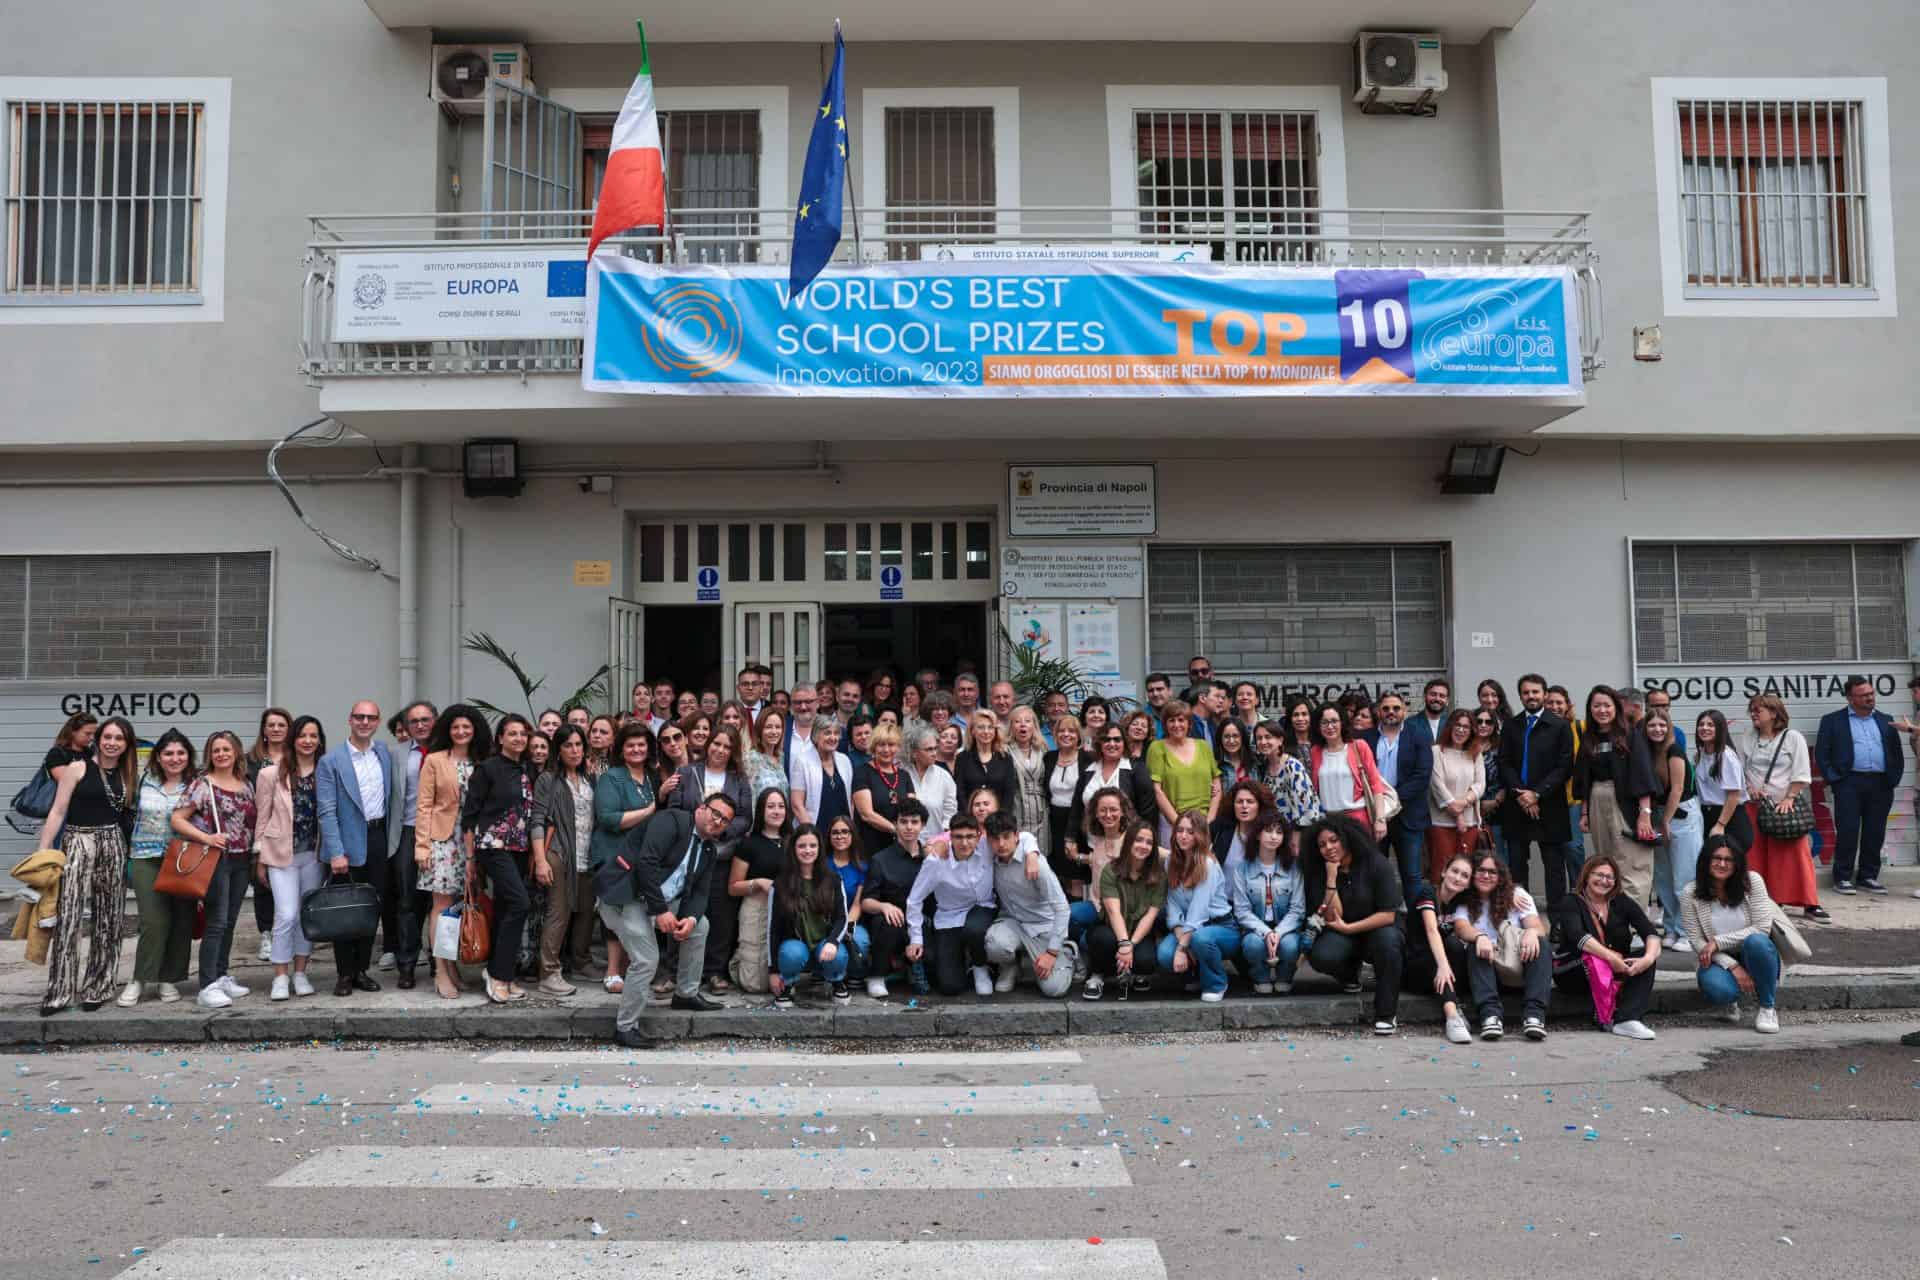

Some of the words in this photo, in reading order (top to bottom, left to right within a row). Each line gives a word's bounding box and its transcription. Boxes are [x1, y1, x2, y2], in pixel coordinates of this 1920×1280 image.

[523, 261, 545, 269] STATO
[972, 251, 1012, 259] ISTITUTO
[1015, 251, 1054, 259] STATALE
[1057, 251, 1109, 259] ISTRUZIONE
[1112, 251, 1160, 259] SUPERIORE
[447, 279, 520, 296] EUROPA
[774, 278, 953, 311] WORLD'S
[970, 278, 1069, 308] BEST
[776, 322, 955, 355] SCHOOL
[970, 321, 1105, 352] PRIZES
[1162, 309, 1307, 356] TOP
[1340, 298, 1406, 348] 10
[1440, 333, 1555, 364] europa
[776, 361, 912, 384] Innovation
[921, 361, 978, 383] 2023
[989, 365, 1030, 379] SIAMO
[1034, 365, 1112, 379] ORGOGLIOSI
[1116, 365, 1129, 379] DI
[1132, 364, 1178, 379] ESSERE
[1181, 364, 1221, 379] NELLA
[1225, 364, 1248, 378] TOP
[1252, 364, 1267, 378] 10
[1271, 364, 1335, 380] MONDIALE
[1040, 482, 1093, 493] Provincia
[1097, 482, 1108, 492] di
[1111, 482, 1147, 494] Napoli
[1643, 676, 1733, 700] SOCIO
[1743, 674, 1896, 698] SANITAO
[61, 692, 200, 717] GRAFICO
